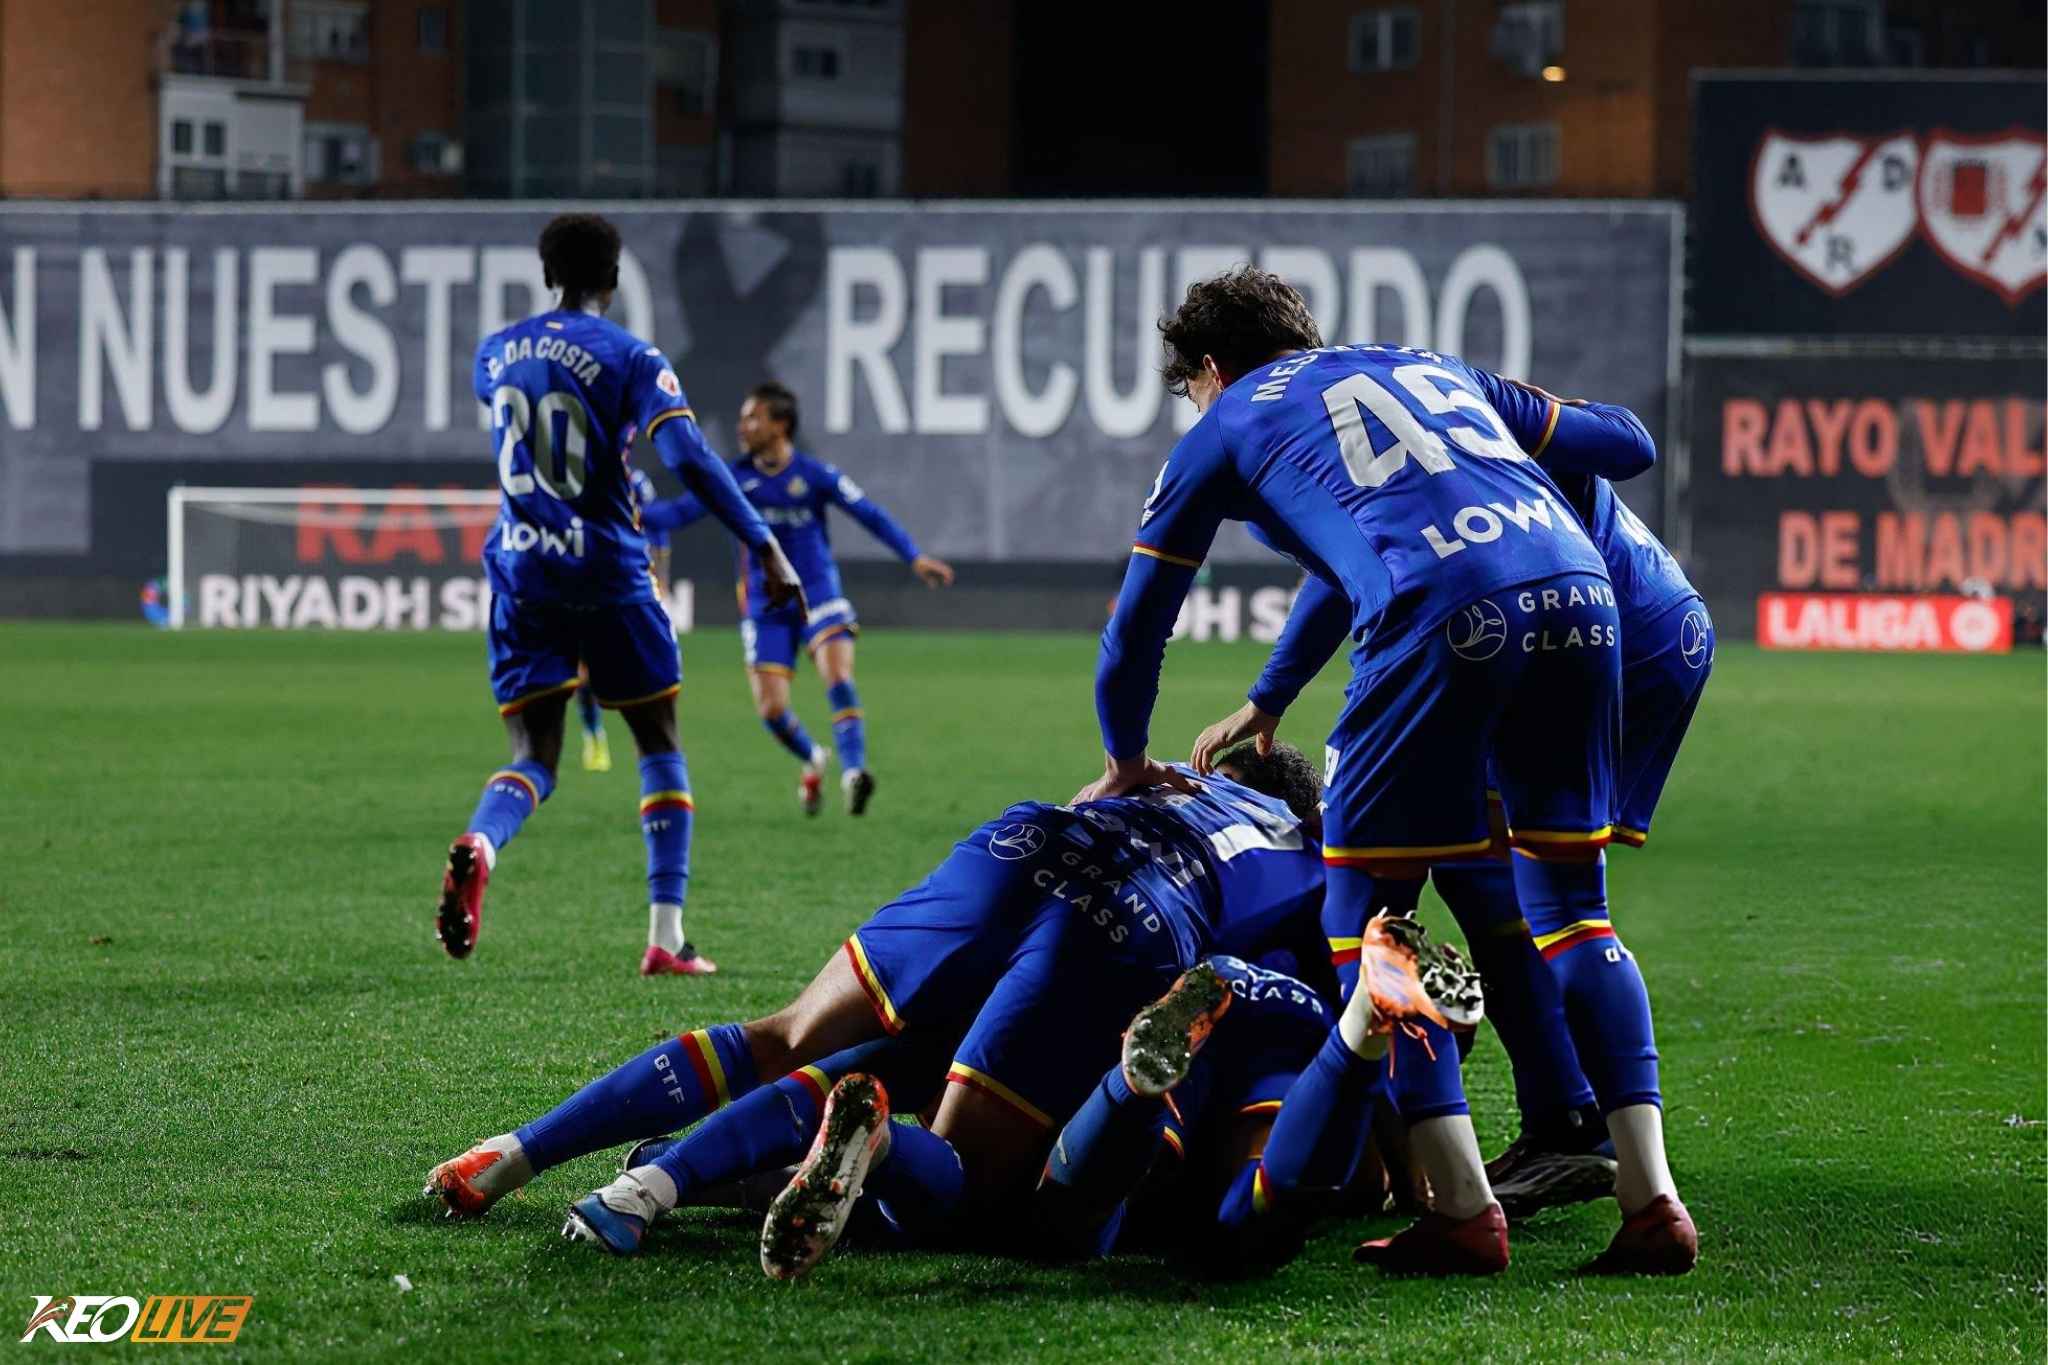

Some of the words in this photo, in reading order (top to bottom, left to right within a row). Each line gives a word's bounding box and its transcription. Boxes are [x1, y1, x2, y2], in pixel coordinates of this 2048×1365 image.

[504, 337, 533, 364] DA
[535, 335, 603, 387] COSTA
[493, 385, 588, 500] 20
[1321, 363, 1531, 489] 45
[1720, 398, 1898, 478] RAYO
[1916, 398, 2046, 478] VAL
[1777, 511, 1861, 590] DE
[201, 574, 431, 630] RIYADH
[1517, 583, 1616, 614] GRAND
[1766, 598, 1943, 647] LALIGA
[1521, 624, 1616, 653] CLASS
[1033, 868, 1129, 944] CLASS
[1061, 851, 1161, 934] GRAND
[654, 1053, 686, 1104] GTF
